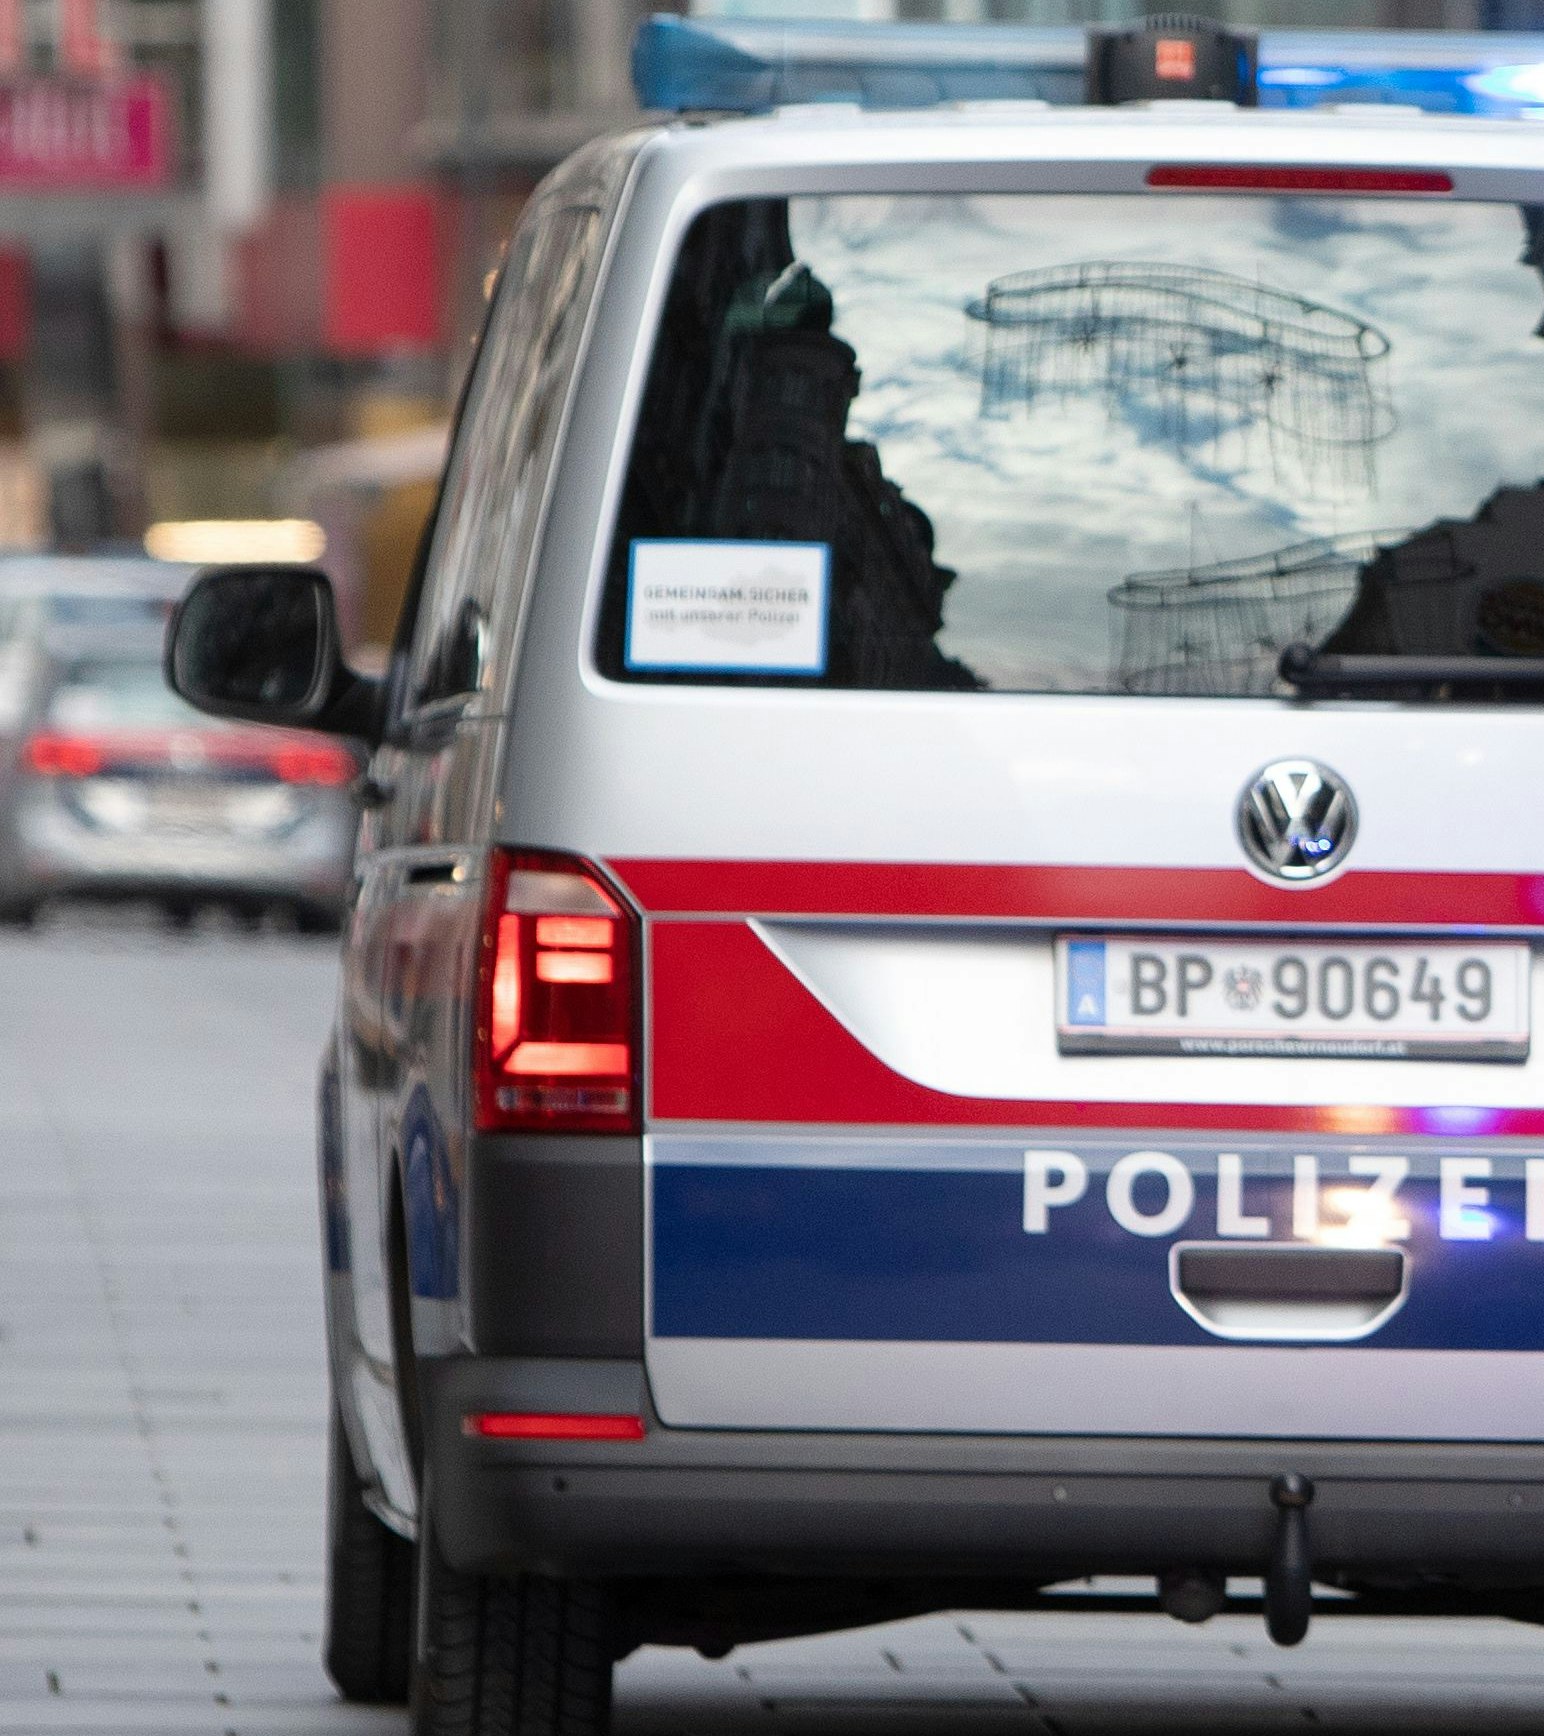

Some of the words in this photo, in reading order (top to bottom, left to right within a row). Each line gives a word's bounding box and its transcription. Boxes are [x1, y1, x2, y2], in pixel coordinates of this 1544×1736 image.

[680, 609, 741, 623] unserer
[747, 608, 800, 624] Polizei
[1129, 951, 1213, 1018] BP
[1271, 954, 1492, 1023] 90649
[1078, 993, 1098, 1016] A
